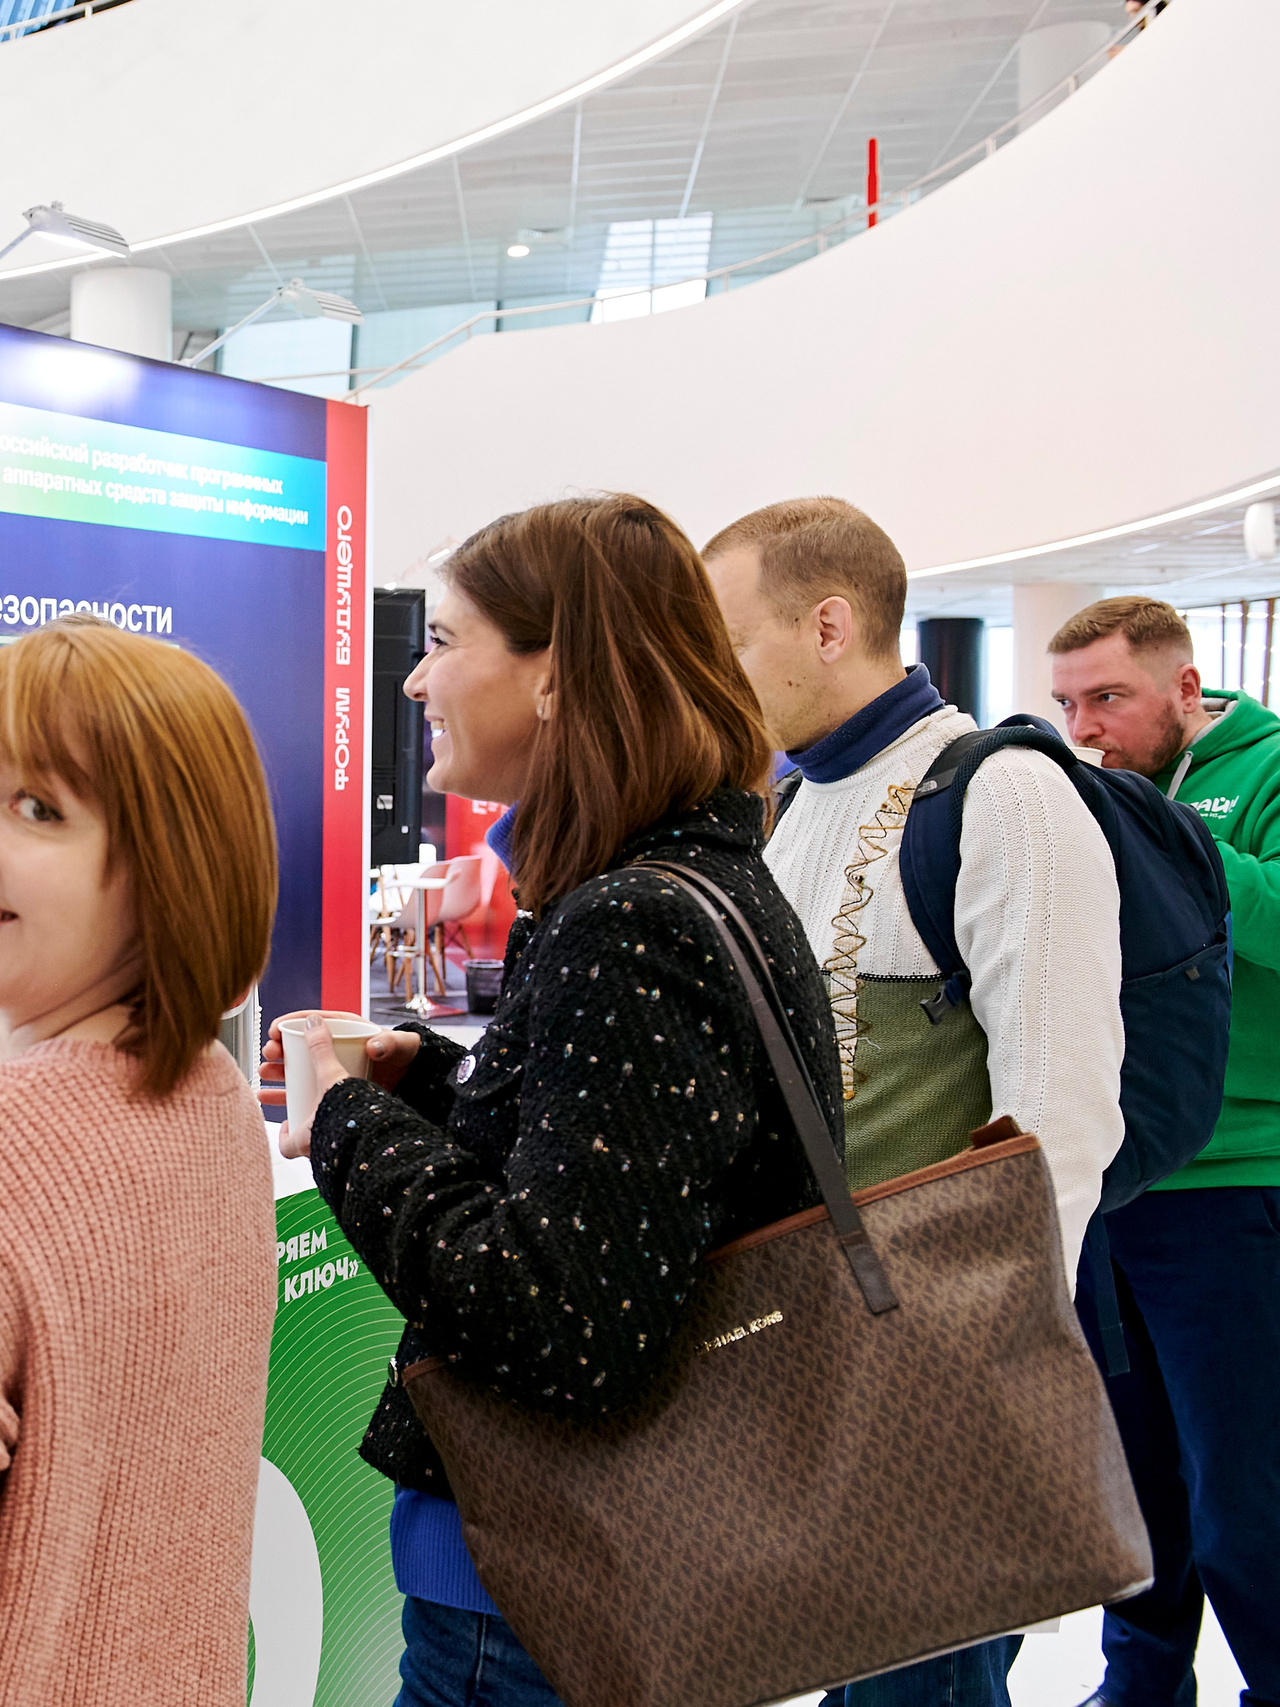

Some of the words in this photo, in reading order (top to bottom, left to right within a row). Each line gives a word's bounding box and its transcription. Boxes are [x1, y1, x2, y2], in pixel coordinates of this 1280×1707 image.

[2, 466, 102, 497] аппаратных
[105, 480, 167, 506] средств
[169, 489, 224, 513] защиты
[225, 494, 309, 527] информации
[92, 448, 188, 481] разработчик
[191, 464, 283, 495] программных
[336, 505, 353, 665] БУДУЩЕГО
[335, 687, 350, 791] ФОРУМ
[284, 1256, 359, 1304] КЛЮЧ»
